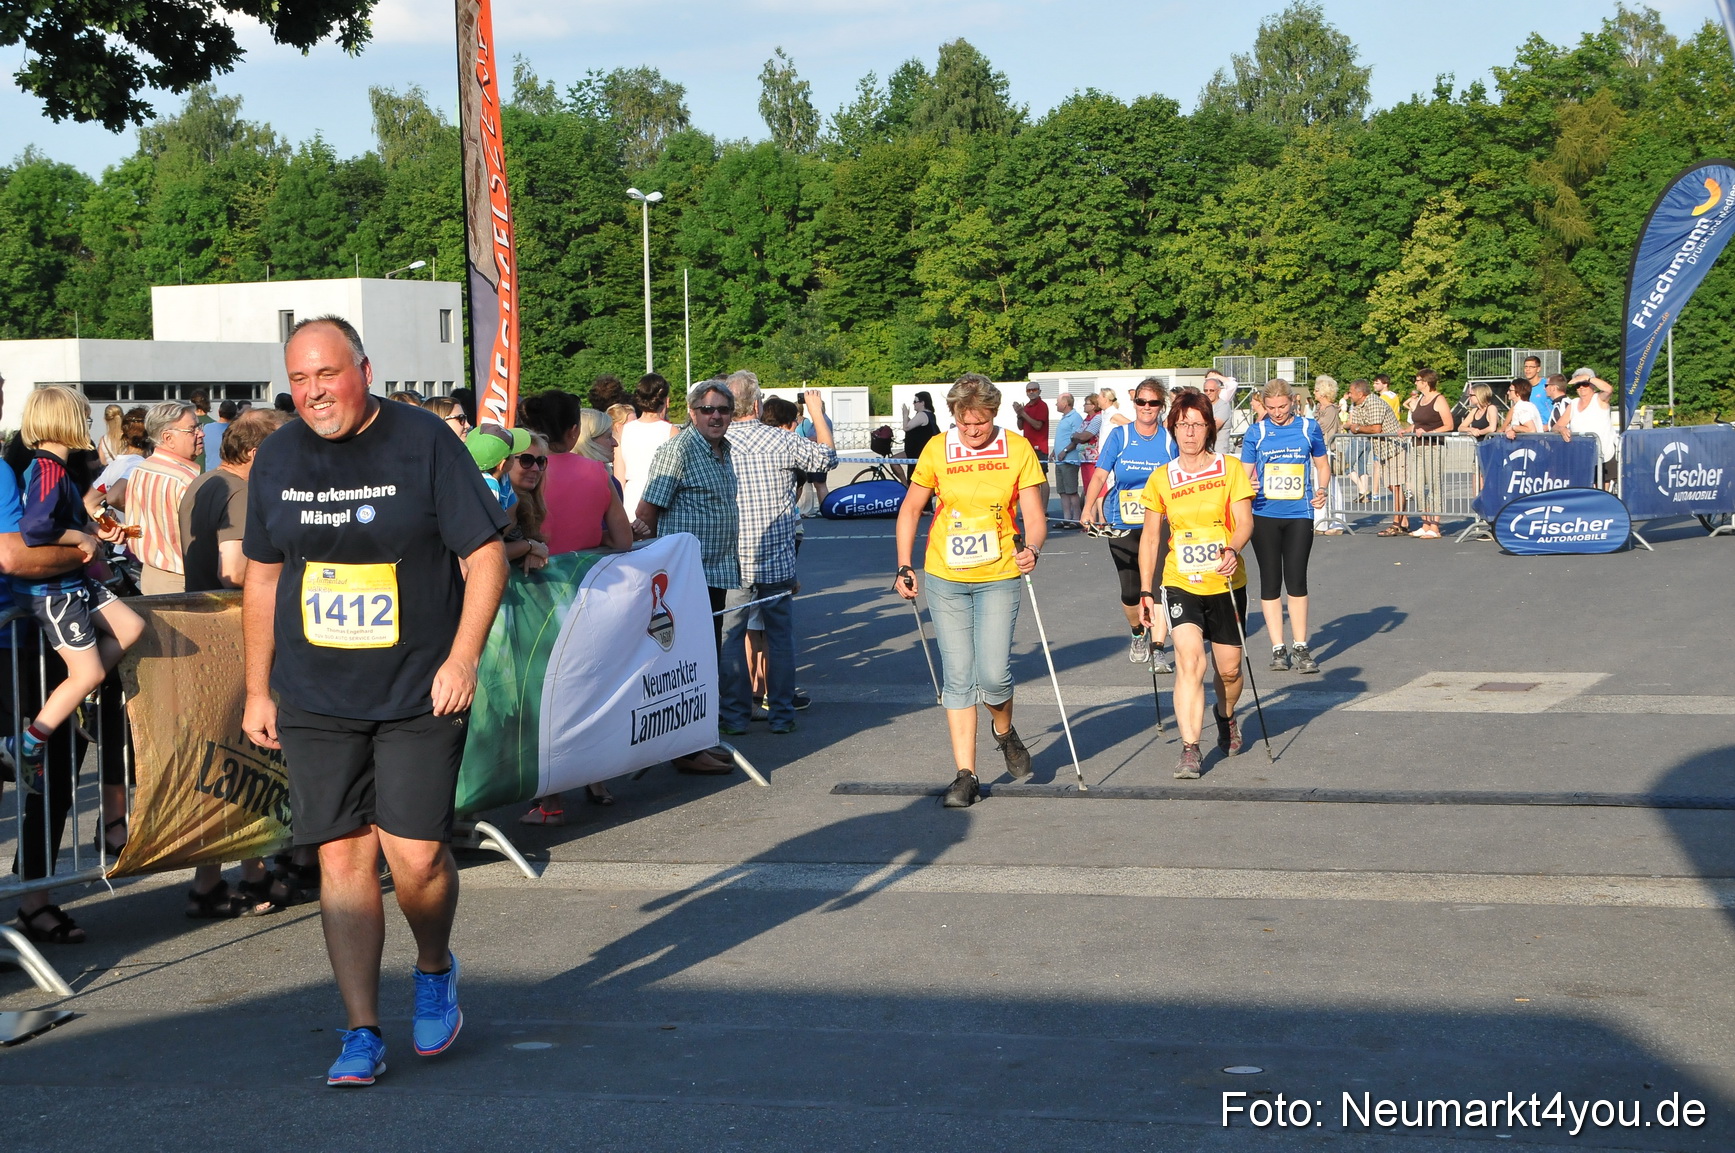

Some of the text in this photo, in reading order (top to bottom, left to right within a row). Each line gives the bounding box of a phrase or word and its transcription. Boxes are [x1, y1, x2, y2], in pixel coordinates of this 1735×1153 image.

[1686, 237, 1709, 266] Druck
[1631, 216, 1713, 330] Frischmann
[946, 460, 1010, 475] MAX BÖGL
[1668, 463, 1723, 488] Fischer
[1171, 480, 1227, 500] MAX BÖGL
[1265, 476, 1302, 491] 1293
[1507, 471, 1571, 494] Fischer
[281, 484, 397, 503] ohne erkennbare
[1673, 490, 1718, 502] AUTOMOBILE
[845, 497, 900, 514] Fischer
[1121, 502, 1146, 515] 129
[300, 508, 351, 527] Mängel
[1529, 517, 1614, 536] Fischer
[951, 533, 989, 556] 821
[1536, 533, 1608, 544] AUTOMOBILE
[1182, 543, 1218, 564] 838
[306, 593, 393, 627] 1412
[642, 659, 698, 700] Neumarkter
[630, 686, 708, 747] Lammsbräu
